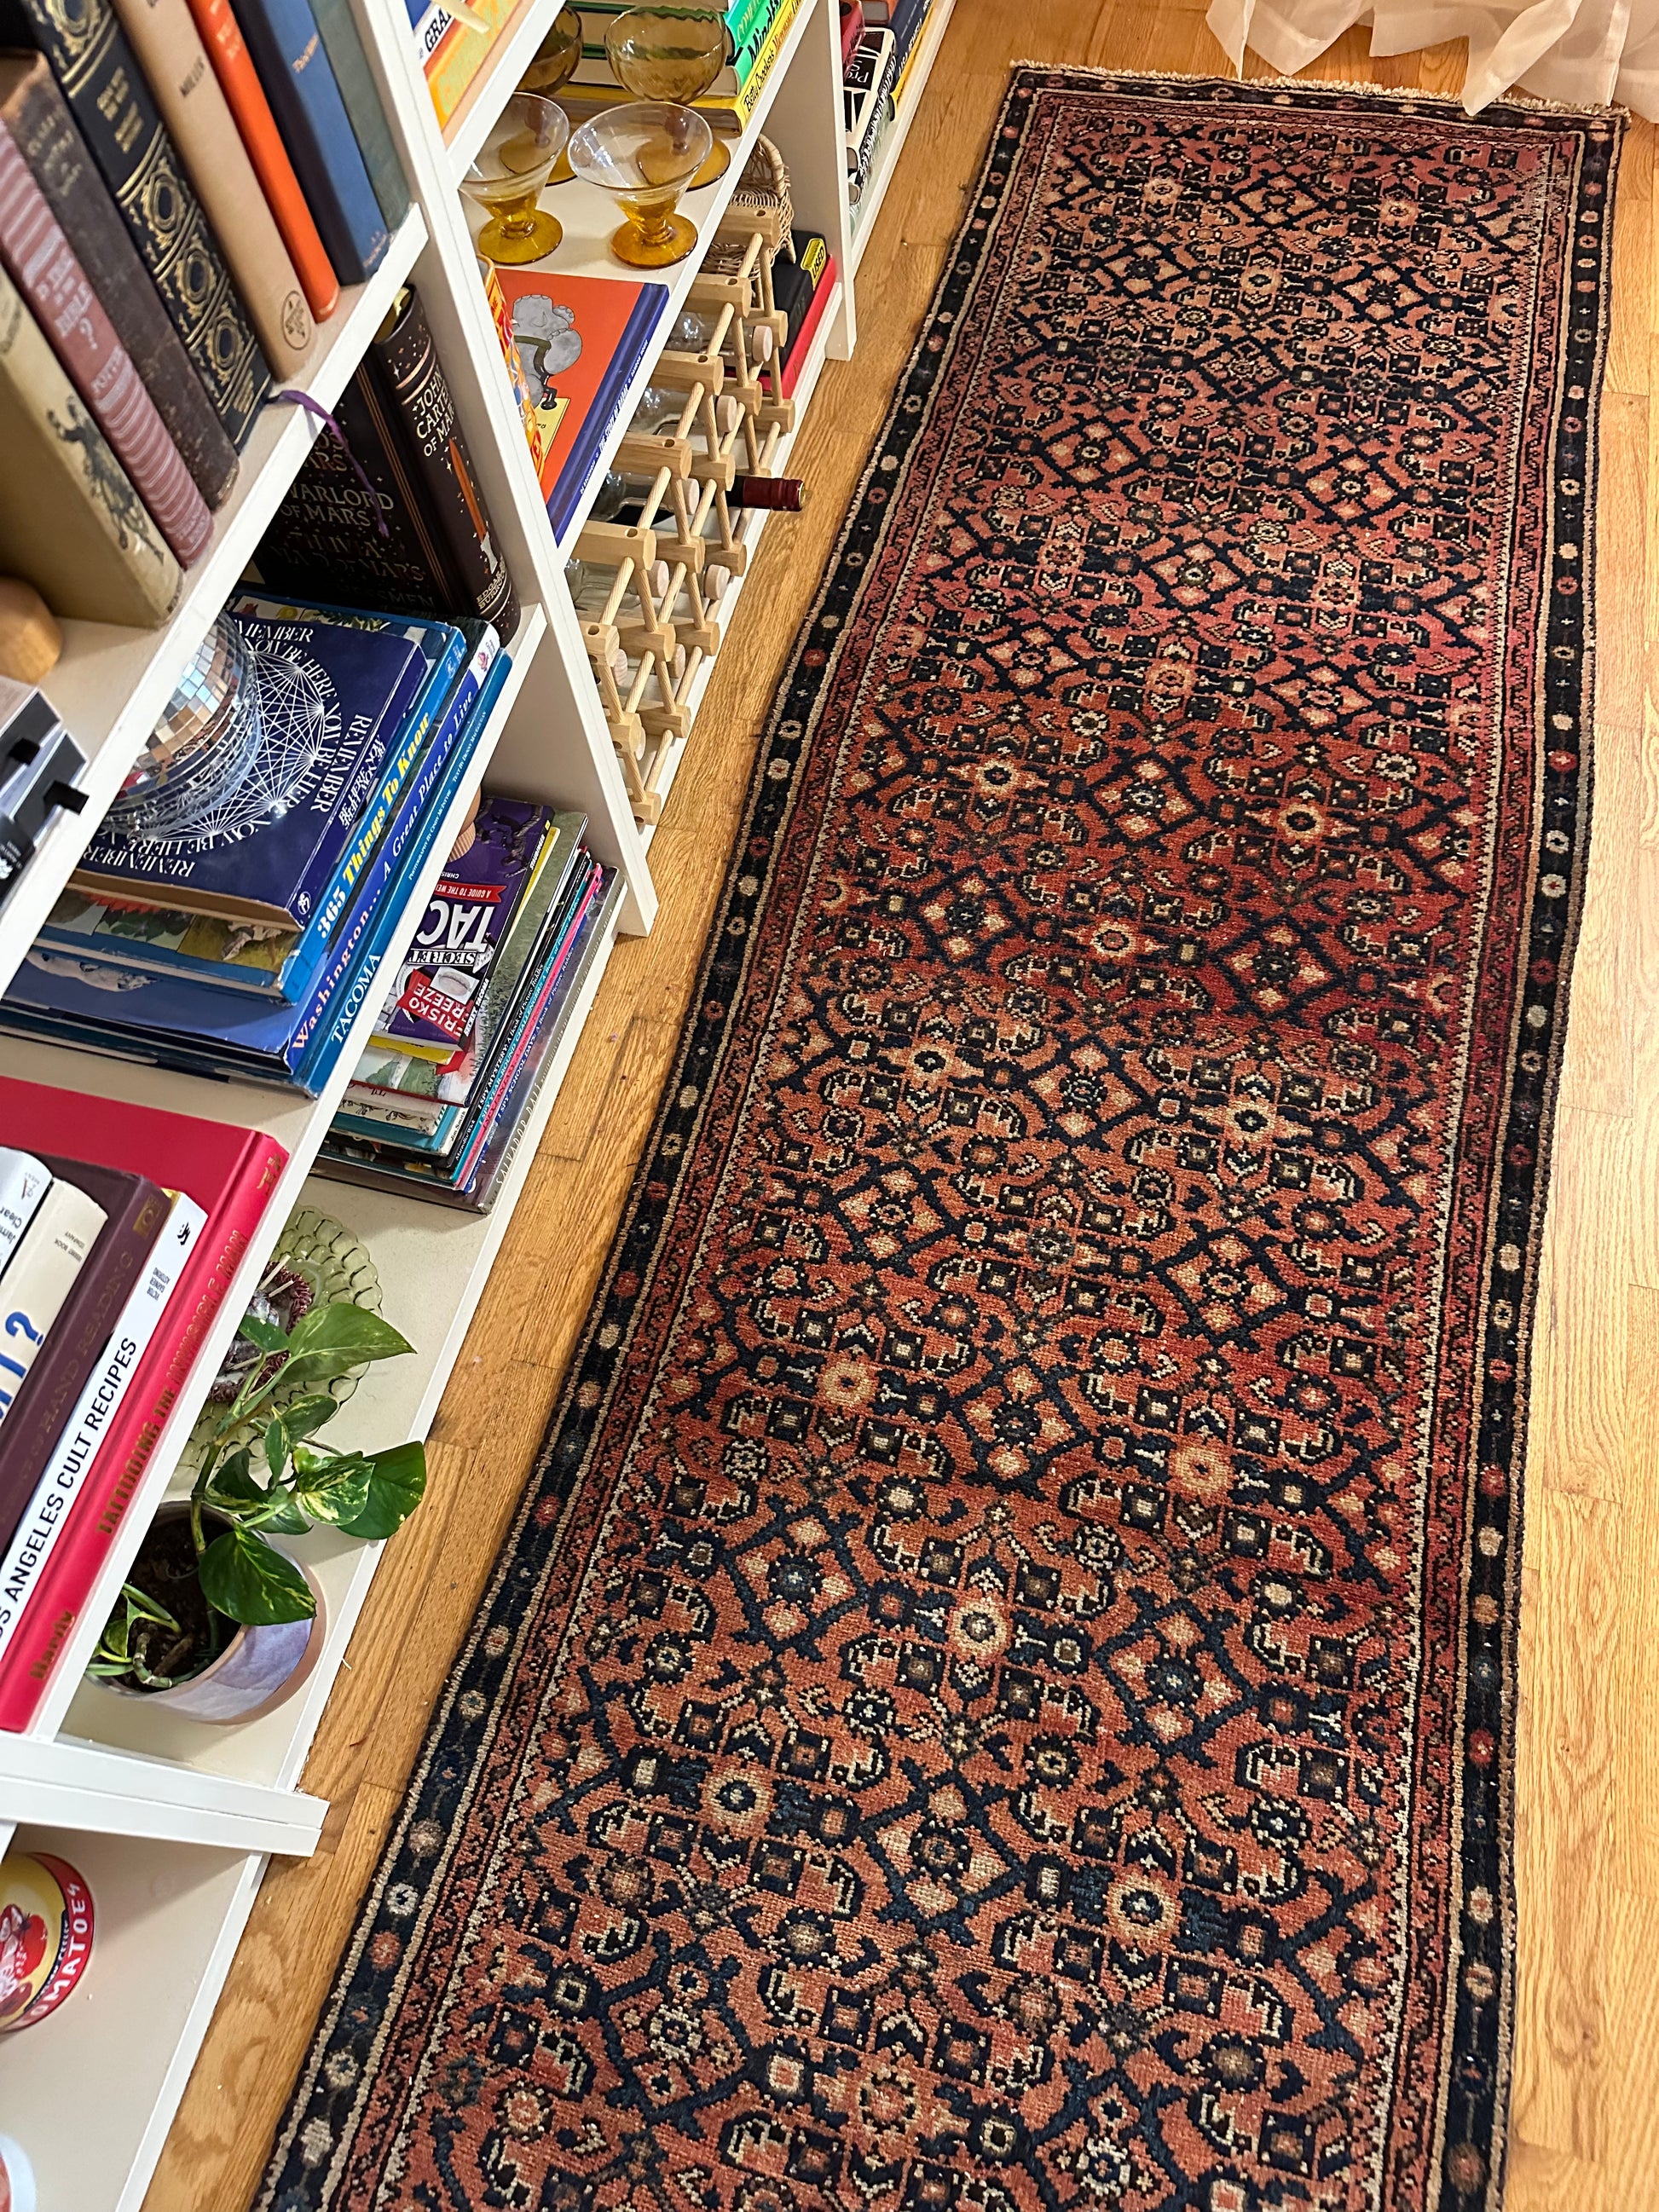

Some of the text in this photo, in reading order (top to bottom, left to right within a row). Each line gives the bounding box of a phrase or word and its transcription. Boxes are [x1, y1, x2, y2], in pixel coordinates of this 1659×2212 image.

[812, 245, 824, 279] USED
[418, 365, 442, 416] JOHN
[424, 437, 436, 456] OF
[303, 503, 372, 528] MARS
[234, 619, 314, 643] MEMBER
[300, 658, 338, 703] HERE
[310, 713, 373, 813] REMEMBER
[392, 806, 419, 858] Great
[419, 754, 443, 803] Place
[442, 732, 454, 757] to
[453, 691, 473, 731] Live
[317, 713, 430, 939] 365 Things To Know
[83, 845, 196, 878] REMEMBER
[447, 885, 458, 894] THE
[460, 887, 468, 896] TO
[469, 888, 487, 898] GUIDE
[416, 900, 495, 952] TAC
[408, 950, 477, 965] SECRET
[331, 954, 381, 1044] TACOMA
[475, 979, 489, 1008] TACOMA
[481, 1087, 489, 1105] SPY
[511, 1019, 520, 1033] Book
[521, 990, 533, 1010] Picture
[530, 964, 544, 989] Riddles
[482, 1102, 491, 1119] SPY
[546, 956, 555, 974] Book
[557, 922, 569, 945] Picture
[500, 1096, 510, 1112] SPY
[508, 1060, 526, 1094] SCHOOL
[539, 1008, 548, 1026] Book
[552, 973, 563, 996] Picture
[562, 946, 574, 972] Riddles
[456, 1111, 466, 1132] Smith
[496, 1119, 526, 1185] SALVADOR
[95, 1421, 160, 1535] TATTOOING
[153, 1389, 177, 1418] THE
[216, 1229, 248, 1278] MAN
[5, 1493, 65, 1604] ANGELES
[57, 1435, 93, 1489] CULT
[84, 1337, 136, 1432] RECIPES
[31, 1883, 89, 2017] OMATOES
